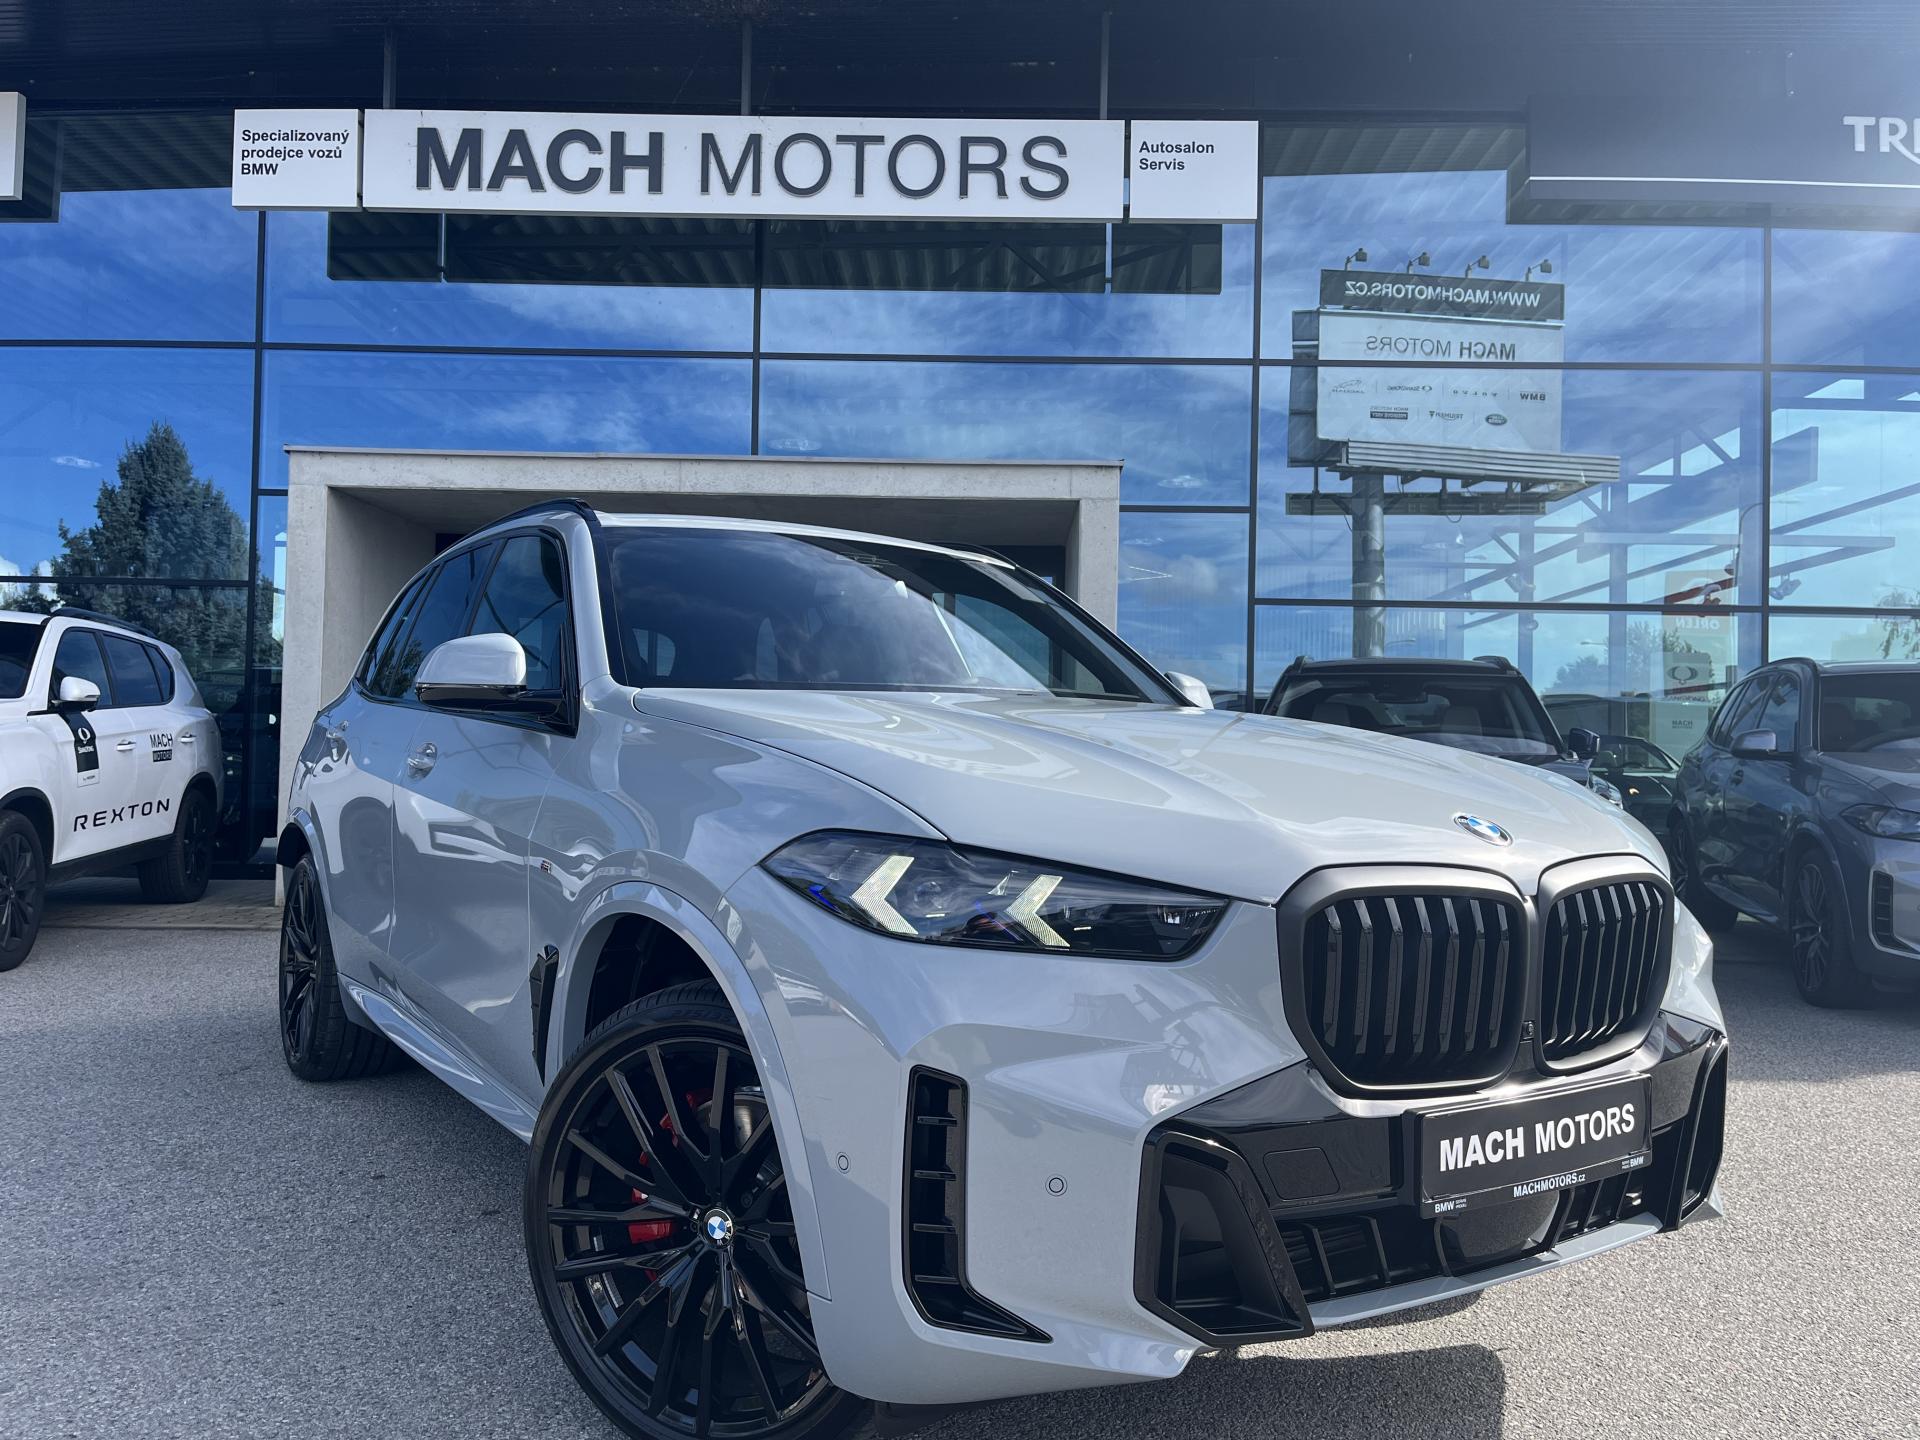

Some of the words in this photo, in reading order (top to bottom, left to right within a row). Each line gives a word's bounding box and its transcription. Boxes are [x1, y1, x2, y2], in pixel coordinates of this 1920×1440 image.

[241, 129, 349, 144] Specializovaný
[241, 147, 304, 162] prodejce
[308, 146, 343, 160] vozů
[1138, 140, 1215, 155] Autosalon
[240, 163, 279, 176] BMW
[415, 127, 664, 195] MACH
[700, 132, 1070, 201] MOTORS
[1138, 158, 1185, 171] Servis
[150, 734, 173, 748] MACH
[73, 798, 170, 832] REXTON
[1439, 1126, 1525, 1172] MACH
[1535, 1103, 1635, 1154] MOTORS
[1435, 1201, 1454, 1213] BMW
